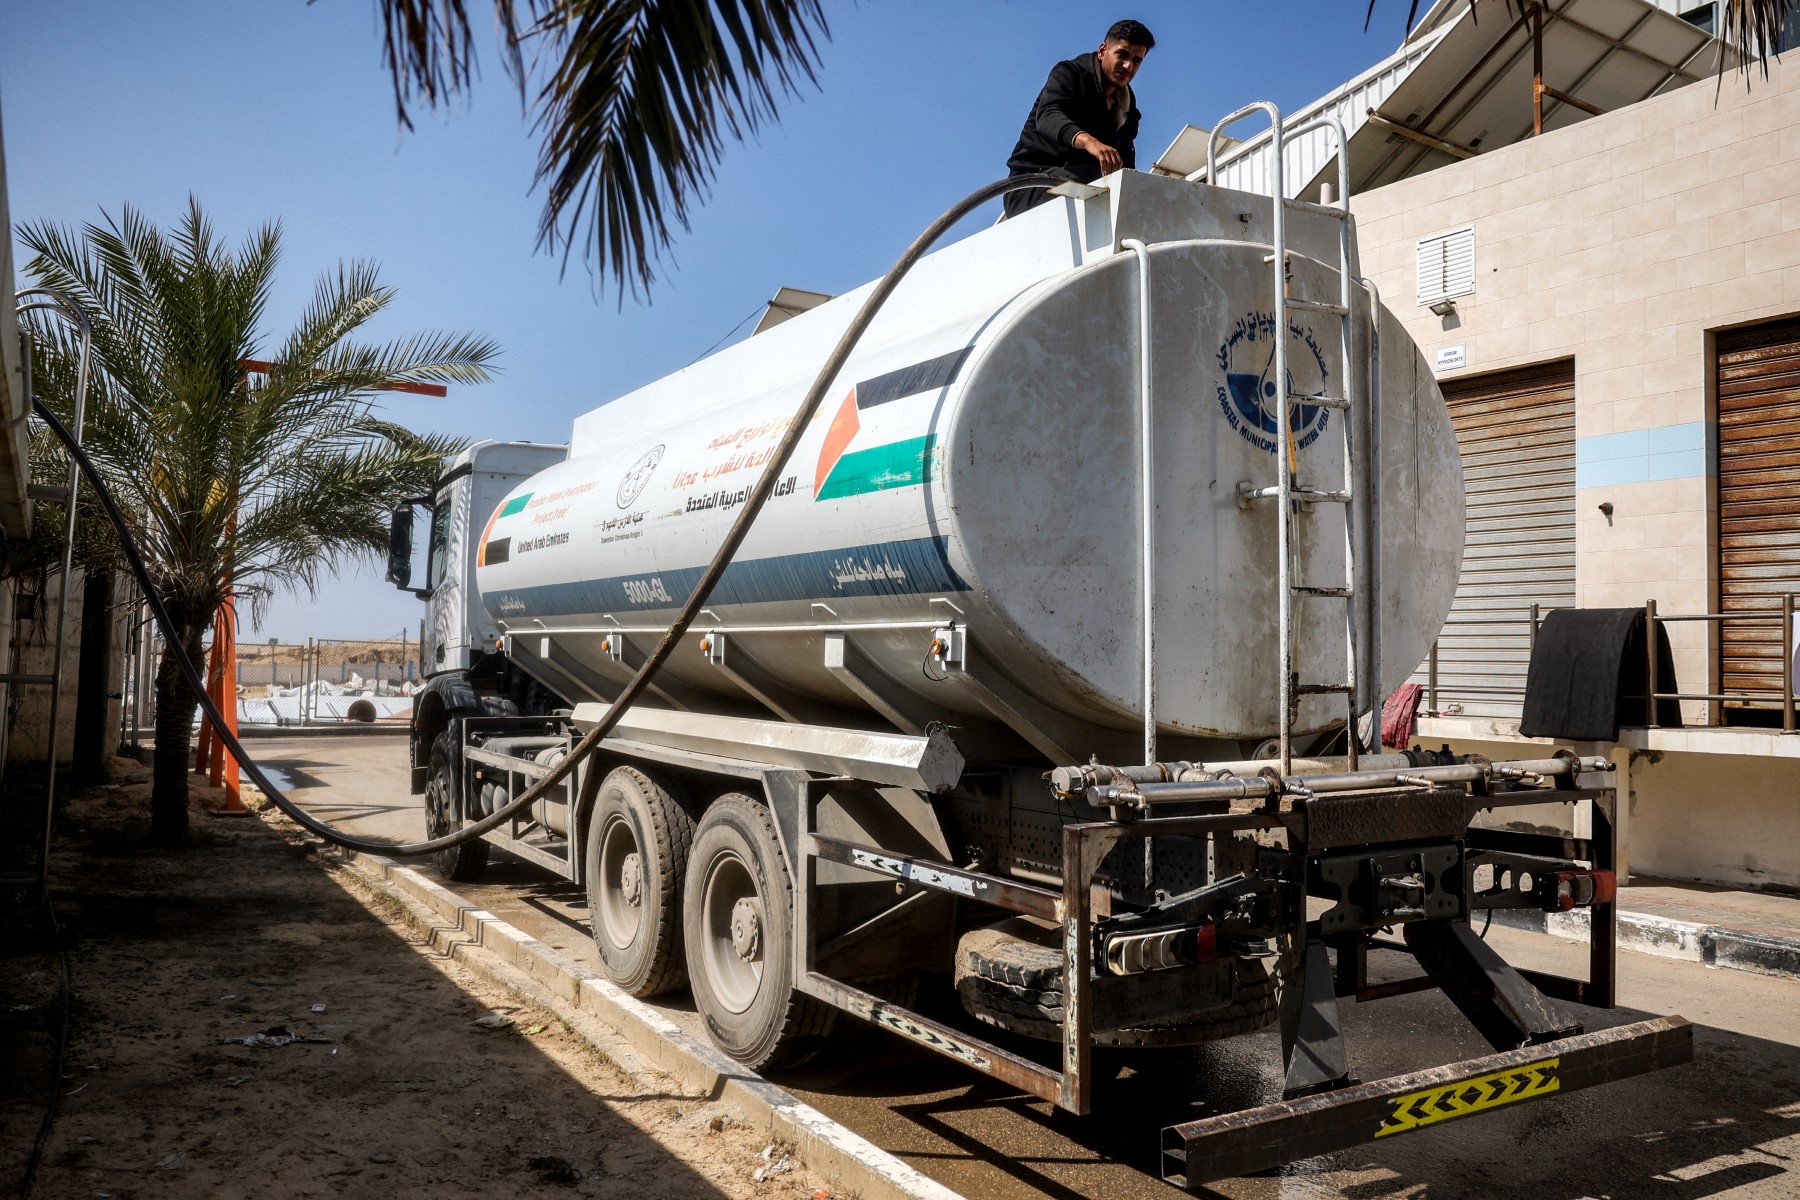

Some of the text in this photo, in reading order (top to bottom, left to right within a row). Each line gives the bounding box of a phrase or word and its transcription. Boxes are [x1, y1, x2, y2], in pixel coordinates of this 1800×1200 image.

[1217, 386, 1240, 430] COASTAL
[1297, 427, 1319, 450] WATER
[686, 491, 719, 513] المتحدة
[517, 531, 570, 554] United Arab Emirates
[622, 577, 673, 604] 5000-GL
